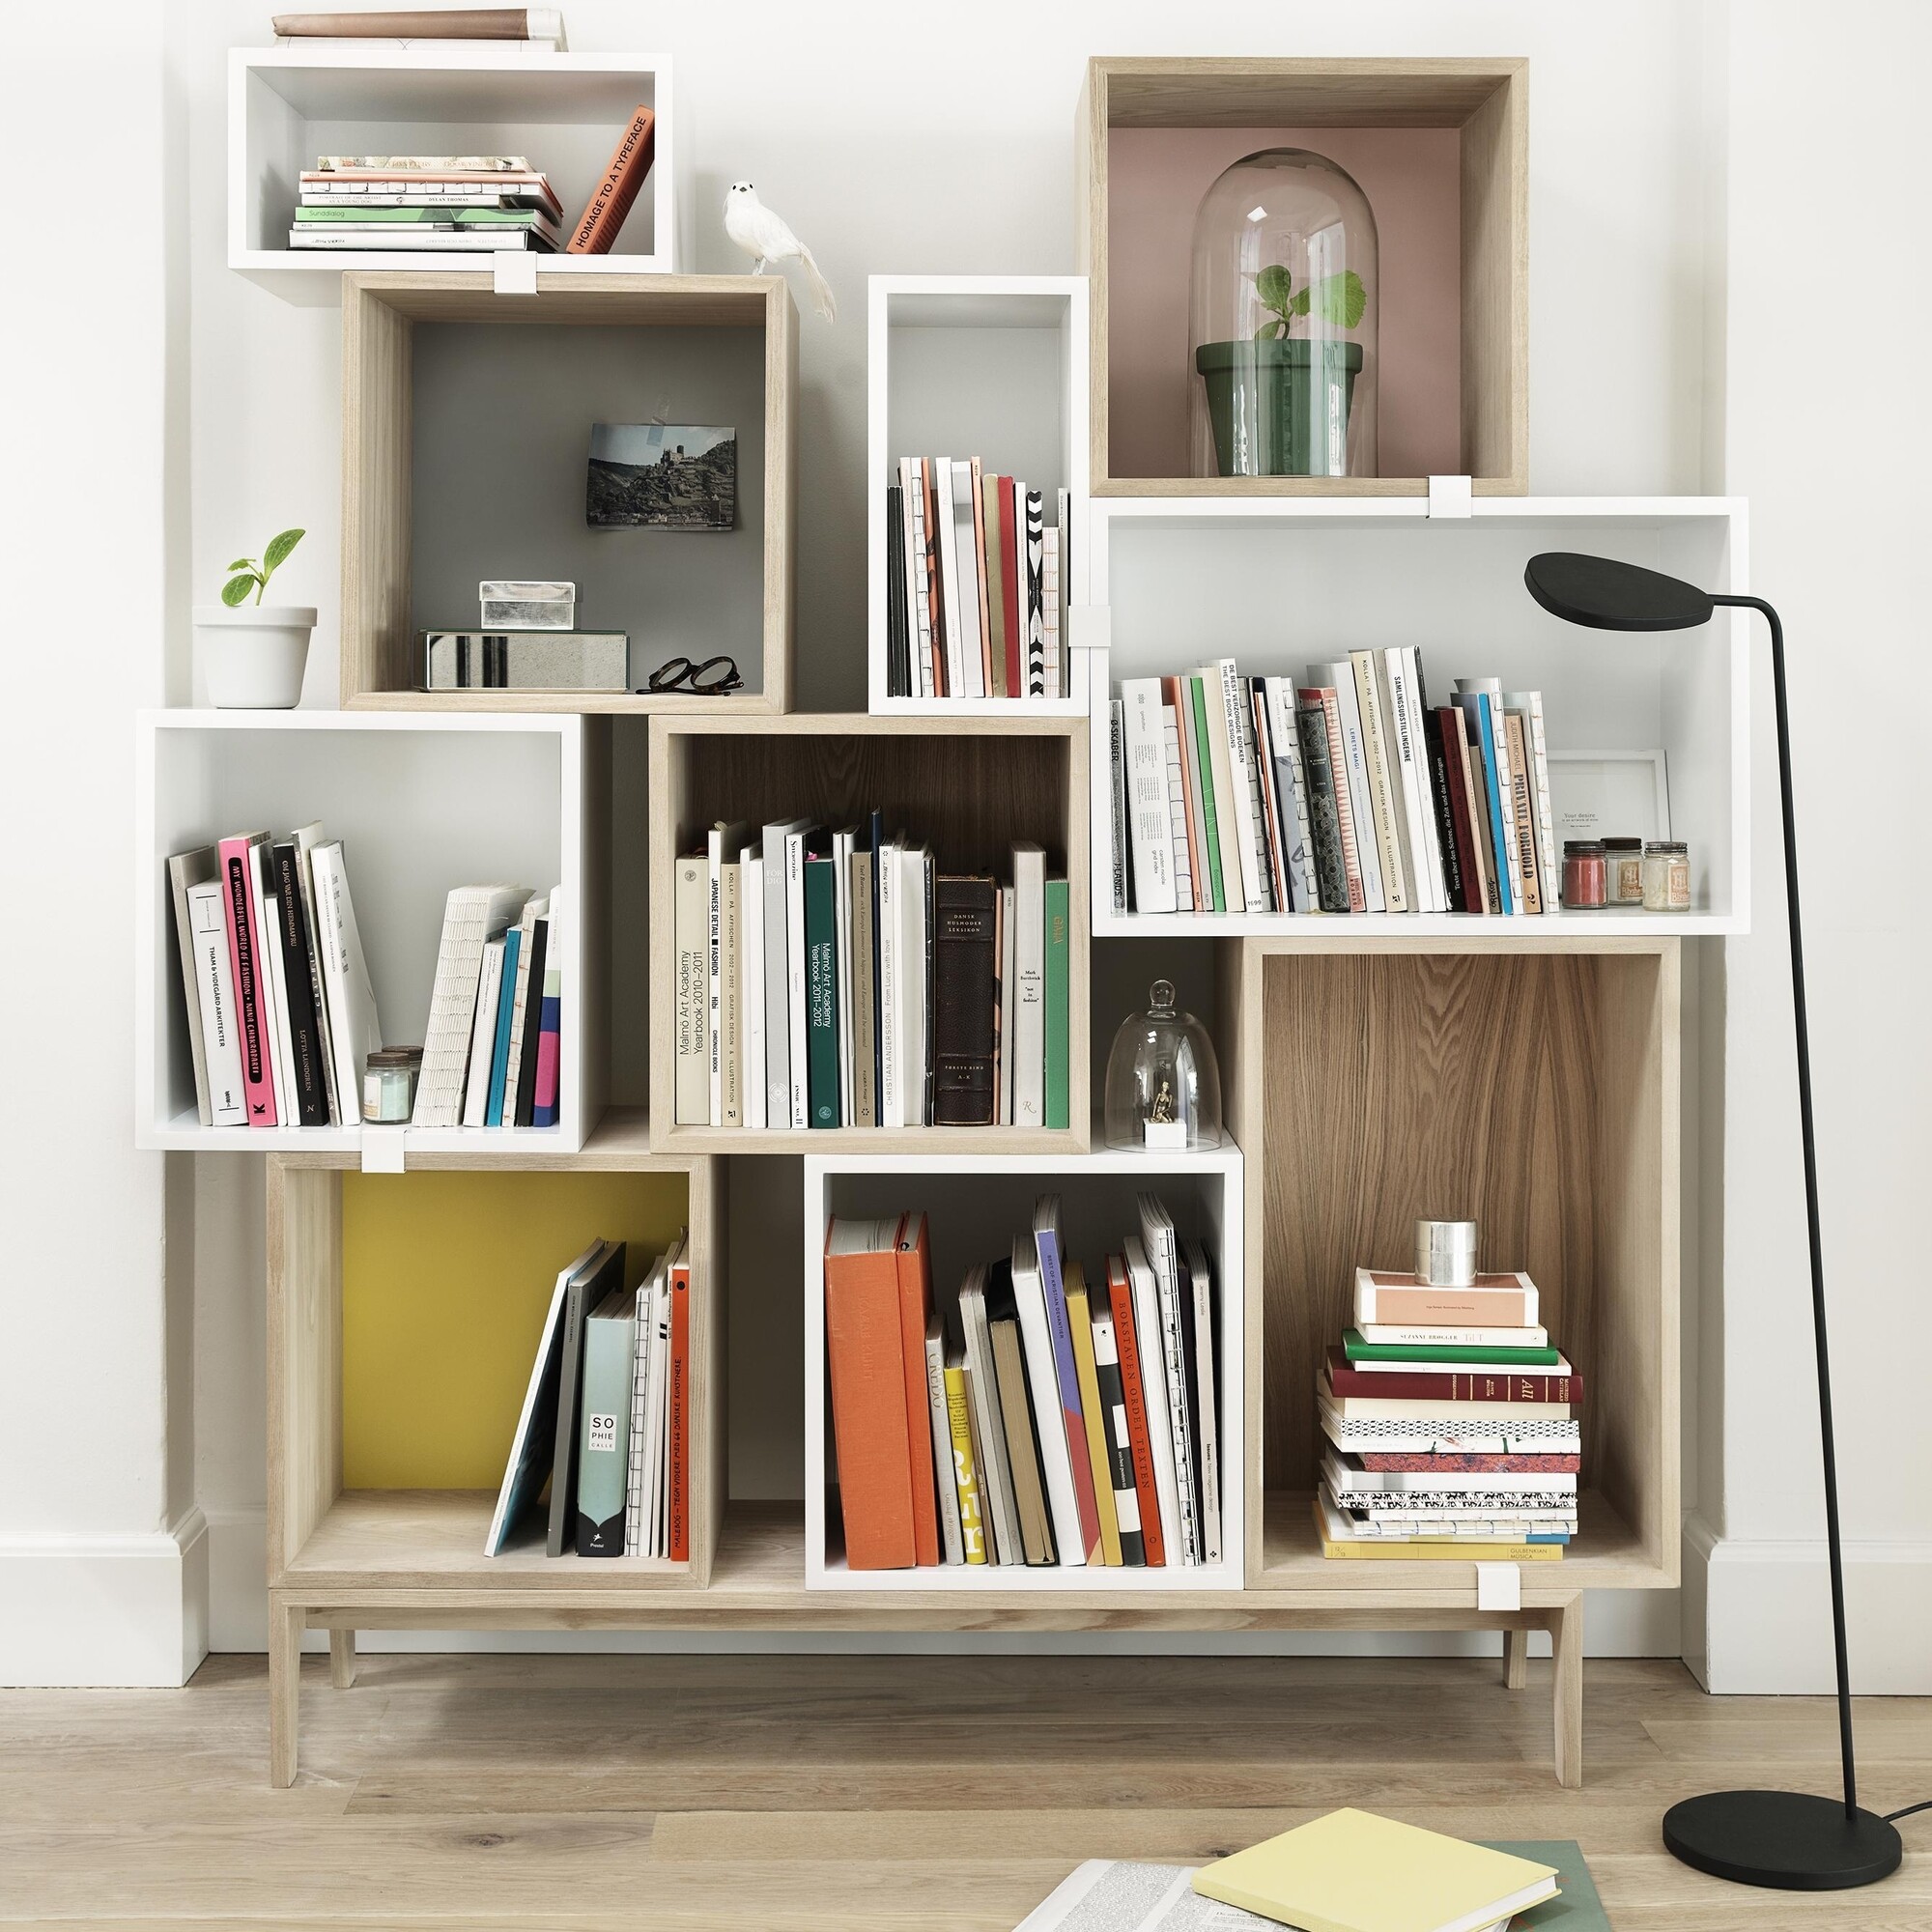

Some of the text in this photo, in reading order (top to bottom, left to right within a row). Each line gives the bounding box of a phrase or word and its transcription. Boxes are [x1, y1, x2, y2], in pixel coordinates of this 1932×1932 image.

[576, 200, 606, 248] HOMAGE
[600, 184, 613, 197] TO
[612, 117, 647, 171] TYPEFACE
[1229, 665, 1235, 673] DE
[1366, 688, 1372, 696] PÅ
[1233, 694, 1241, 734] VERZORGDE
[1368, 701, 1377, 735] AFFISCHEN
[1394, 676, 1411, 762] SAMLINGSUDSTILLINGERNE
[1236, 735, 1245, 763] BOEKEN
[1510, 721, 1521, 771] JUDITH MICHAEL
[1514, 774, 1534, 879] PRIVATE FORHOLD
[282, 860, 289, 871] OM
[282, 872, 291, 883] JAG
[1386, 845, 1397, 888] ILLUSTRATION
[1527, 894, 1536, 904] 2
[287, 910, 297, 947] HEMMAFRU
[233, 866, 259, 1073] MY WONDERFUL WORLD OF FASHION NINA CHAKRABARTI
[822, 943, 831, 972] Malmö
[212, 972, 221, 1006] VIDEGÅRD
[679, 951, 691, 1055] Malmö Art Academy
[693, 952, 703, 1055] Yearbook 2010–2011
[811, 944, 822, 1027] Yearbook 2011–2012
[215, 1007, 225, 1047] ARKITEKTER
[823, 989, 832, 1028] Academy
[302, 1054, 312, 1092] LUNDGREN
[1055, 1307, 1064, 1339] DEVANTIER
[925, 1352, 947, 1408] CREDO
[1119, 1302, 1150, 1489] BOKSTAVEN ORDET TEXTEN
[1521, 1378, 1534, 1399] All
[591, 1432, 612, 1440] PHIE
[592, 1417, 613, 1429] SO
[673, 1432, 680, 1440] 66
